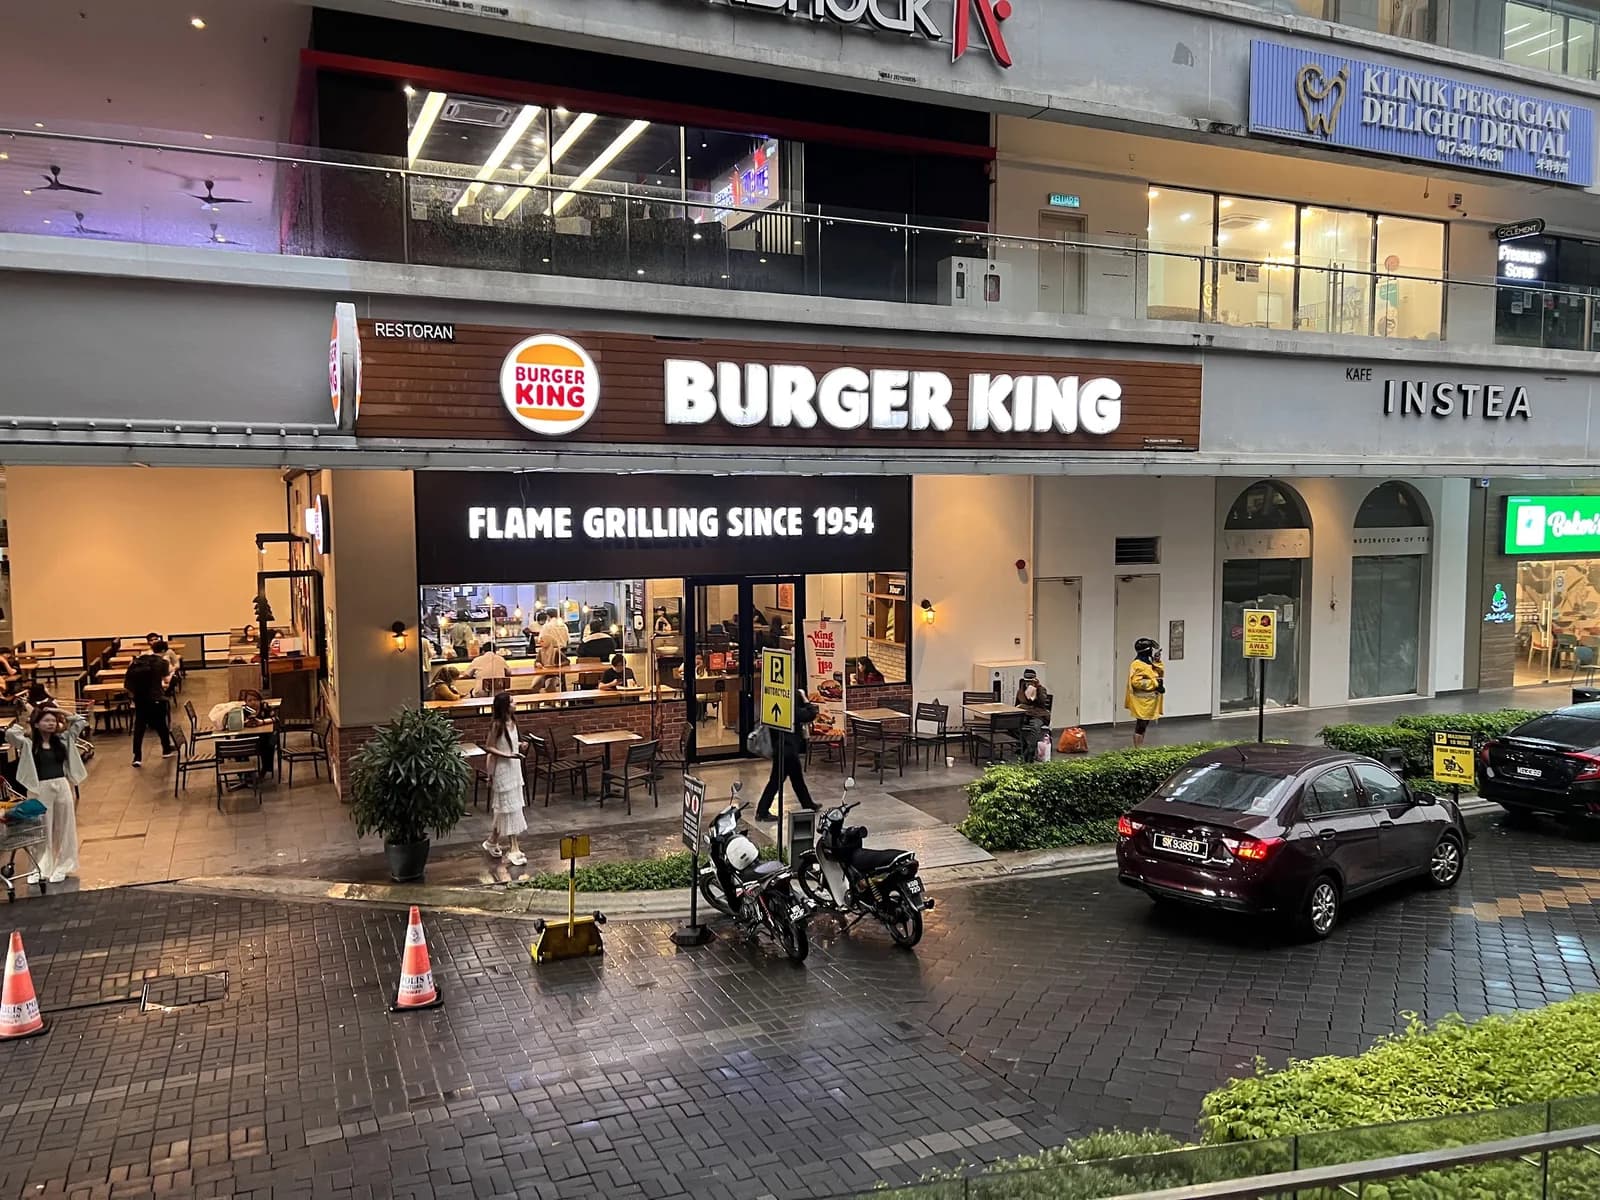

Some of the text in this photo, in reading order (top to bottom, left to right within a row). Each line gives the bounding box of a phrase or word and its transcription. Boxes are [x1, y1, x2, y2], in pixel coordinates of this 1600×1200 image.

[1362, 68, 1572, 131] KLINIK PERGIGIAN
[1361, 96, 1571, 158] DELIGHT DENTAL
[375, 322, 453, 340] RESTORAN
[515, 366, 585, 385] BURGER
[1346, 368, 1372, 381] KAFE
[515, 383, 585, 408] KING
[664, 359, 1122, 435] BURGER KING
[1384, 380, 1533, 419] INSTEA
[468, 506, 875, 539] FLAME GRILLING SINCE 1954
[811, 637, 835, 649] Value
[814, 631, 834, 641] King
